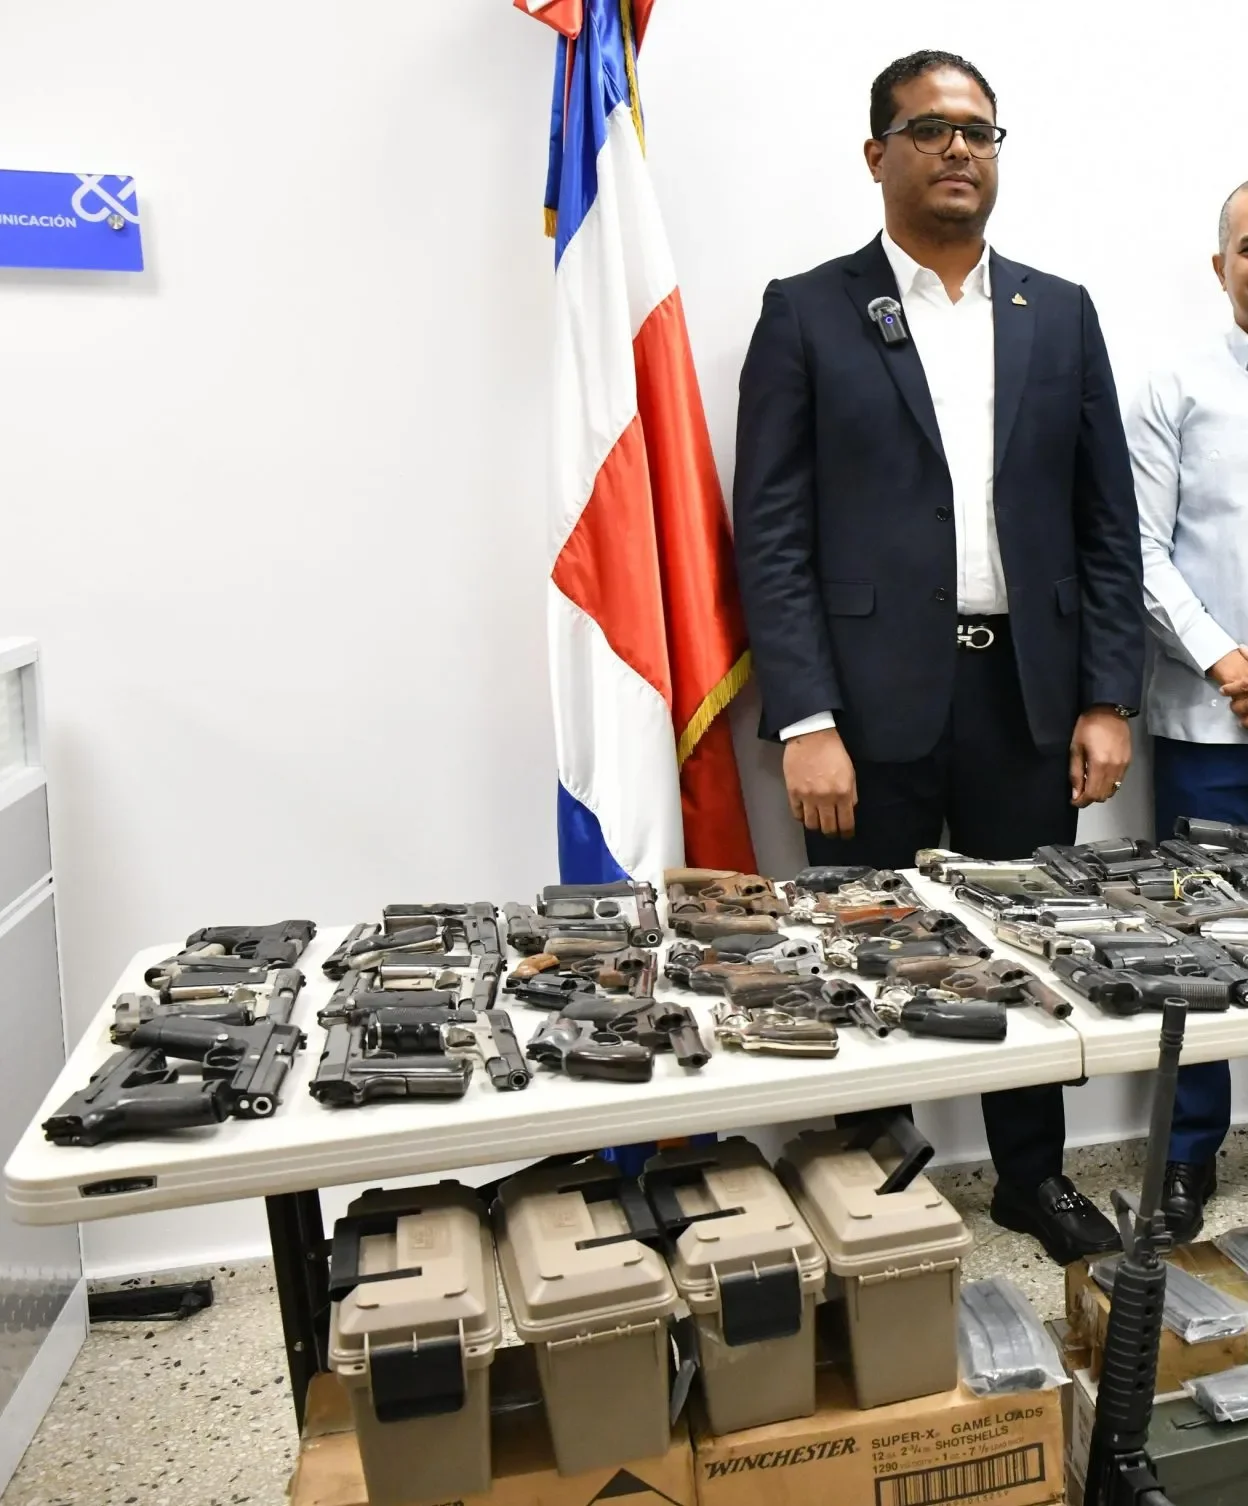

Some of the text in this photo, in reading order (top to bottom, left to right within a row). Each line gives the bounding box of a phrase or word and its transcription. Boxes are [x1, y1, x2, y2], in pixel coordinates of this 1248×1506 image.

[871, 1407, 1044, 1450] SUPER-X GAME LOADS
[871, 1451, 885, 1461] 12
[935, 1425, 1009, 1450] SHOTSHELLS
[704, 1436, 857, 1481] WINCHESTER
[872, 1461, 899, 1474] 1290
